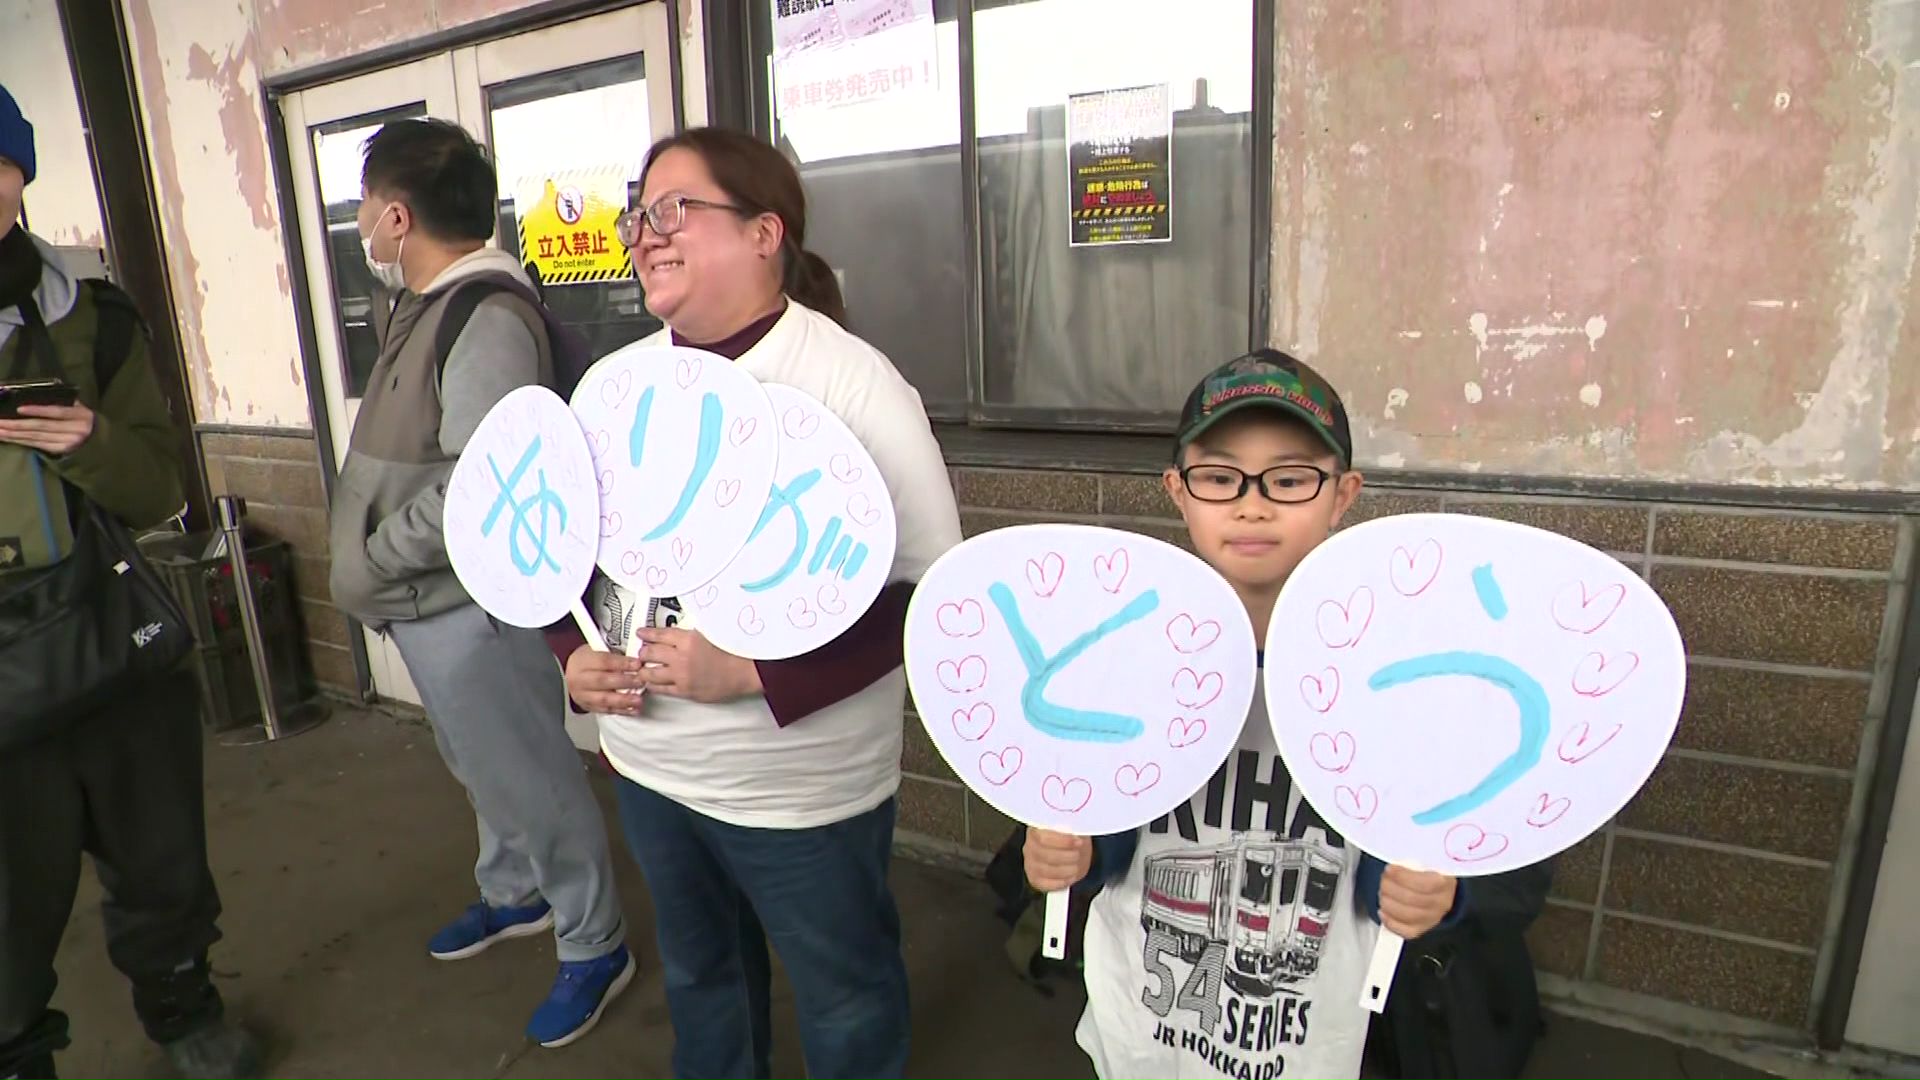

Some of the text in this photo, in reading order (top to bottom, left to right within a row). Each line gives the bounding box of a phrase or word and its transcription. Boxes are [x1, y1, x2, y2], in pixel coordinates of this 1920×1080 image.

[538, 229, 609, 258] 立入禁止
[553, 259, 595, 269] Do not enter
[1141, 927, 1229, 1036] 54
[1153, 1021, 1285, 1080] JR HOKKAIDO
[1223, 996, 1312, 1052] SERIES
